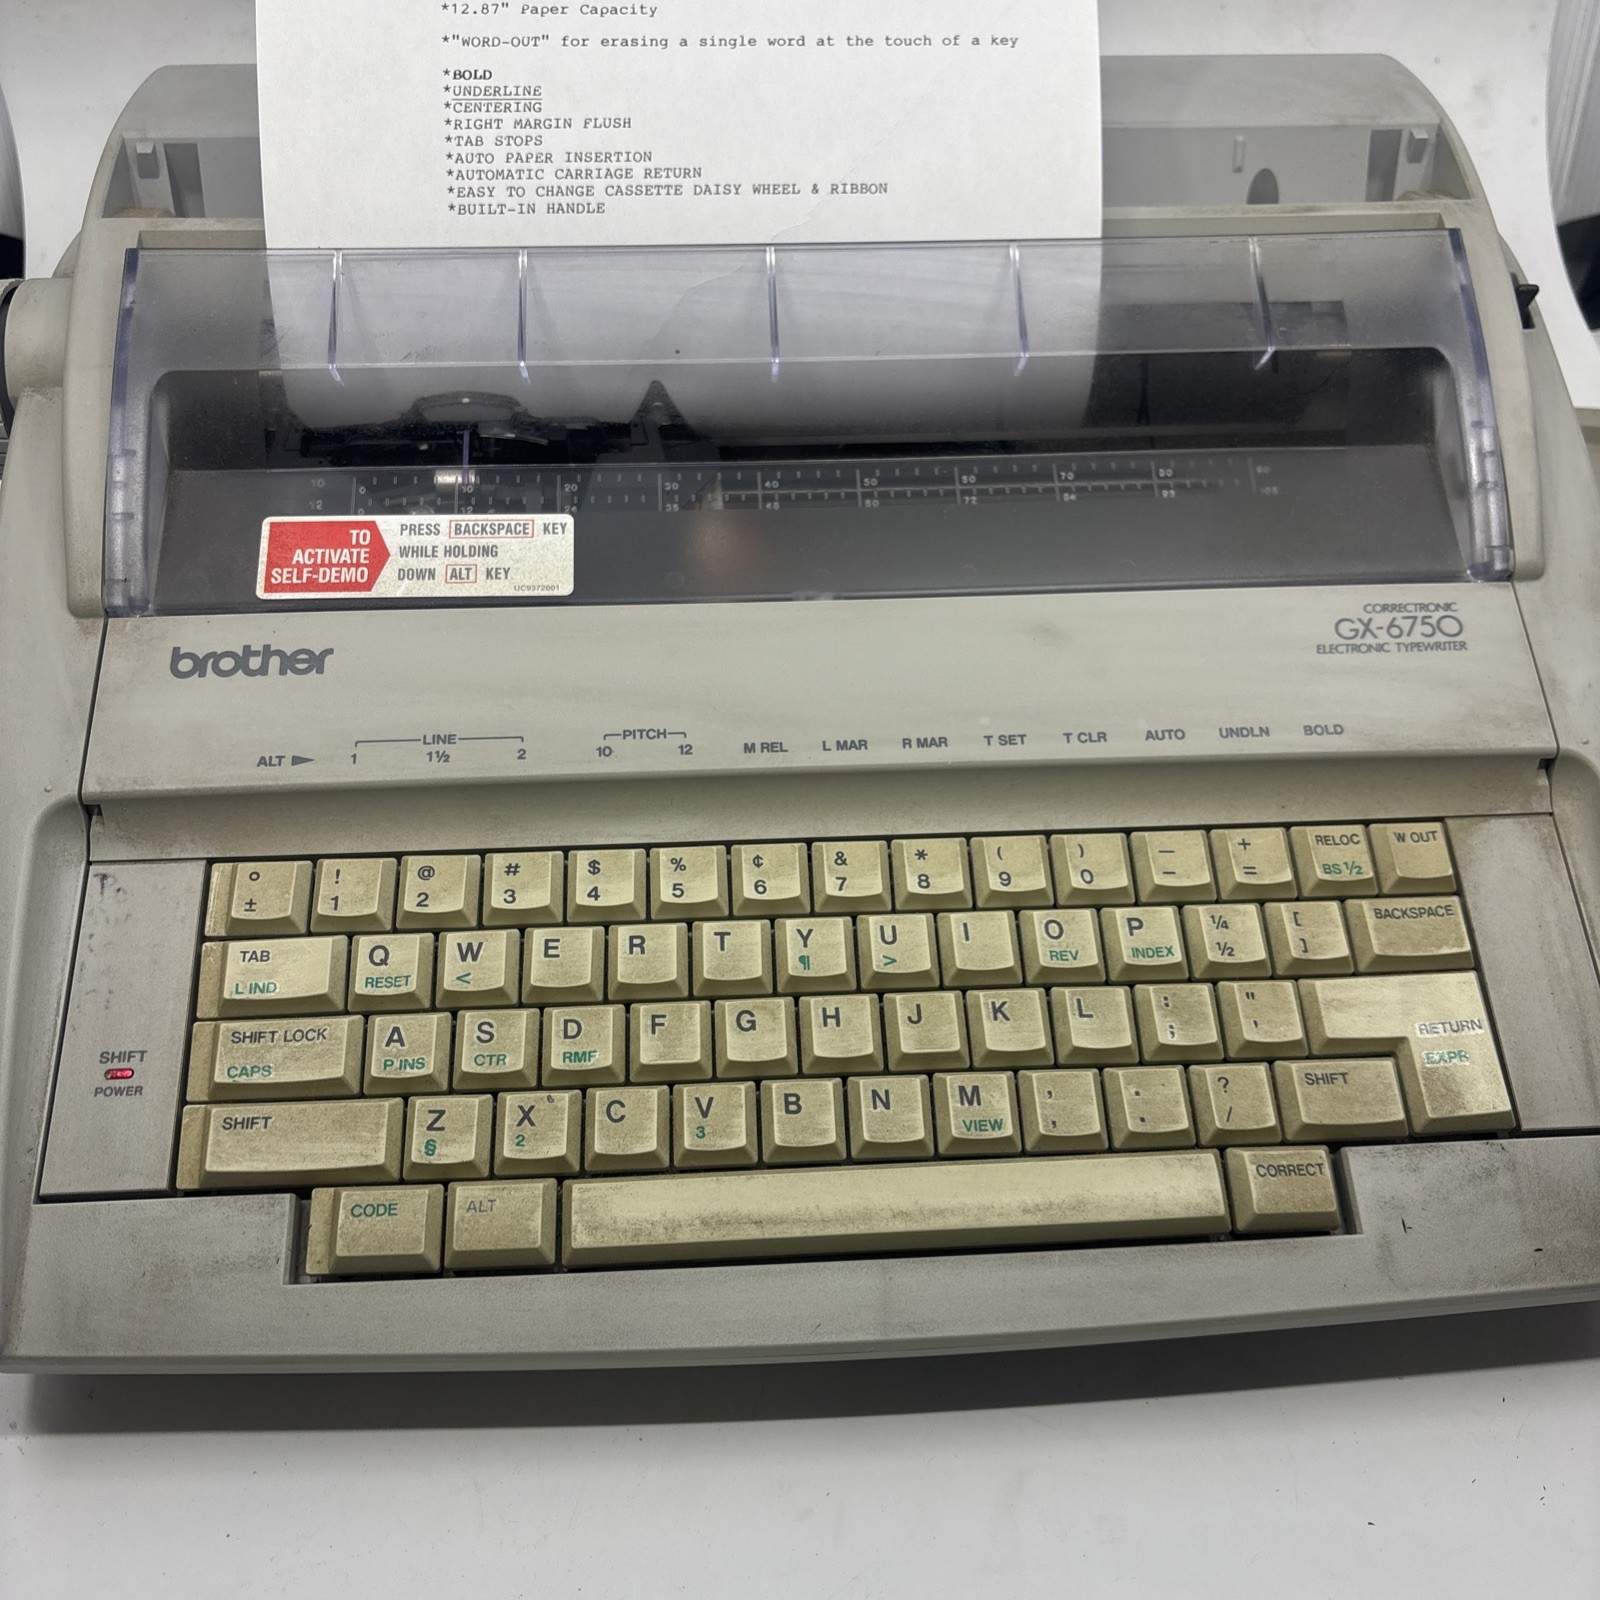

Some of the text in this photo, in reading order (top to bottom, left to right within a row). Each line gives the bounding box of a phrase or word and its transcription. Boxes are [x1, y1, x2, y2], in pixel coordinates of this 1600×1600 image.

[520, 3, 569, 17] Paper
[580, 3, 658, 17] Capacity
[561, 35, 590, 47] for
[600, 35, 669, 50] erasing
[679, 38, 689, 47] a
[699, 35, 757, 49] single
[767, 36, 806, 47] word
[816, 36, 834, 47] at
[846, 35, 874, 47] the
[885, 35, 932, 47] touch
[942, 35, 960, 47] of
[971, 38, 980, 47] a
[991, 35, 1019, 48] key
[513, 118, 573, 130] MARGIN
[583, 117, 632, 129] FLUSH
[494, 135, 544, 147] STOPS
[505, 152, 554, 164] PAPER
[564, 151, 653, 163] INSERTION
[554, 168, 633, 180] CARRIAGE
[643, 167, 703, 180] RETURN
[506, 185, 526, 197] TO
[535, 185, 595, 197] CHANGE
[604, 185, 683, 197] CASSETTE
[693, 184, 742, 196] DAISY
[752, 184, 801, 196] WHEEL
[811, 184, 820, 196] &
[829, 183, 888, 196] RIBBON
[546, 203, 606, 215] HANDLE
[462, 480, 780, 494] 10 20 30 40
[399, 521, 568, 537] PRESS BACKSPACE KEY
[349, 530, 372, 545] TO
[291, 549, 370, 565] ACTIVATE
[398, 544, 499, 559] WHILE HOLDING
[271, 567, 369, 584] SELF-DEMO
[397, 567, 510, 581] DOWN ALT KEY
[514, 584, 560, 592] UC9372001
[1363, 602, 1458, 614] CORRECTRONIC
[1334, 614, 1464, 640] GX-6750
[1316, 640, 1468, 655] ELECTRONIC TYPEWRITER
[169, 644, 335, 679] brother
[622, 728, 667, 741] PITCH
[1063, 731, 1108, 744] T CLR
[1145, 728, 1186, 742] AUTO
[1218, 726, 1270, 739] UNDLN
[1303, 724, 1344, 737] BOLD
[423, 733, 457, 746] LINE
[822, 739, 869, 752] L MAR
[902, 736, 949, 750] R MAR
[983, 734, 1027, 747] T SET
[596, 744, 693, 758] 10 12
[743, 741, 789, 754] M REL
[256, 755, 286, 767] ALT
[350, 753, 358, 765] 1
[517, 748, 527, 760] 2
[1315, 833, 1361, 846] RELOC
[1394, 831, 1437, 843] W OUT
[835, 876, 848, 892] 7
[917, 874, 931, 890] 8
[998, 871, 1012, 887] 9
[1080, 869, 1094, 884] 0
[587, 885, 601, 902] 4
[671, 883, 685, 899] 5
[753, 879, 768, 895] 6
[330, 895, 341, 911] 1
[415, 892, 430, 908] 2
[502, 888, 517, 904] 3
[1373, 905, 1454, 920] BACKSPACE
[1044, 919, 1065, 940] O
[1126, 917, 1144, 936] P
[1209, 914, 1229, 930] ¼
[796, 928, 814, 948] Y
[879, 925, 898, 945] U
[962, 922, 970, 942] I
[543, 938, 561, 958] E
[628, 935, 647, 955] R
[713, 932, 732, 951] T
[1215, 941, 1235, 957] ½
[240, 950, 271, 963] TAB
[368, 945, 390, 967] Q
[457, 942, 484, 962] W
[1050, 950, 1079, 962] REV
[1131, 946, 1175, 959] INDEX
[235, 981, 278, 994] L IND
[364, 975, 412, 989] RESET
[907, 1004, 923, 1025] J
[991, 1001, 1010, 1022] K
[1075, 998, 1094, 1019] L
[651, 1014, 668, 1035] F
[736, 1009, 757, 1032] G
[822, 1007, 841, 1028] H
[476, 1021, 495, 1043] S
[563, 1018, 583, 1039] D
[1418, 1018, 1483, 1036] RETURN
[231, 1028, 328, 1044] SHIFT LOCK
[385, 1026, 406, 1048] A
[99, 1050, 148, 1064] SHIFT
[383, 1057, 426, 1071] P INS
[473, 1053, 507, 1067] CTR
[562, 1050, 598, 1064] RMF
[227, 1064, 272, 1079] CAPS
[1304, 1072, 1349, 1086] SHIFT
[94, 1085, 143, 1098] POWER
[958, 1085, 981, 1107] M
[784, 1093, 803, 1115] B
[871, 1089, 891, 1111] N
[605, 1100, 627, 1124] C
[694, 1097, 715, 1119] V
[222, 1116, 272, 1131] SHIFT
[427, 1110, 446, 1131] Z
[517, 1105, 536, 1127] X
[695, 1126, 707, 1139] 3
[962, 1118, 1004, 1132] VIEW
[515, 1134, 527, 1148] 2
[1256, 1163, 1324, 1178] CORRECT
[350, 1203, 398, 1218] CODE
[466, 1200, 497, 1214] ALT
